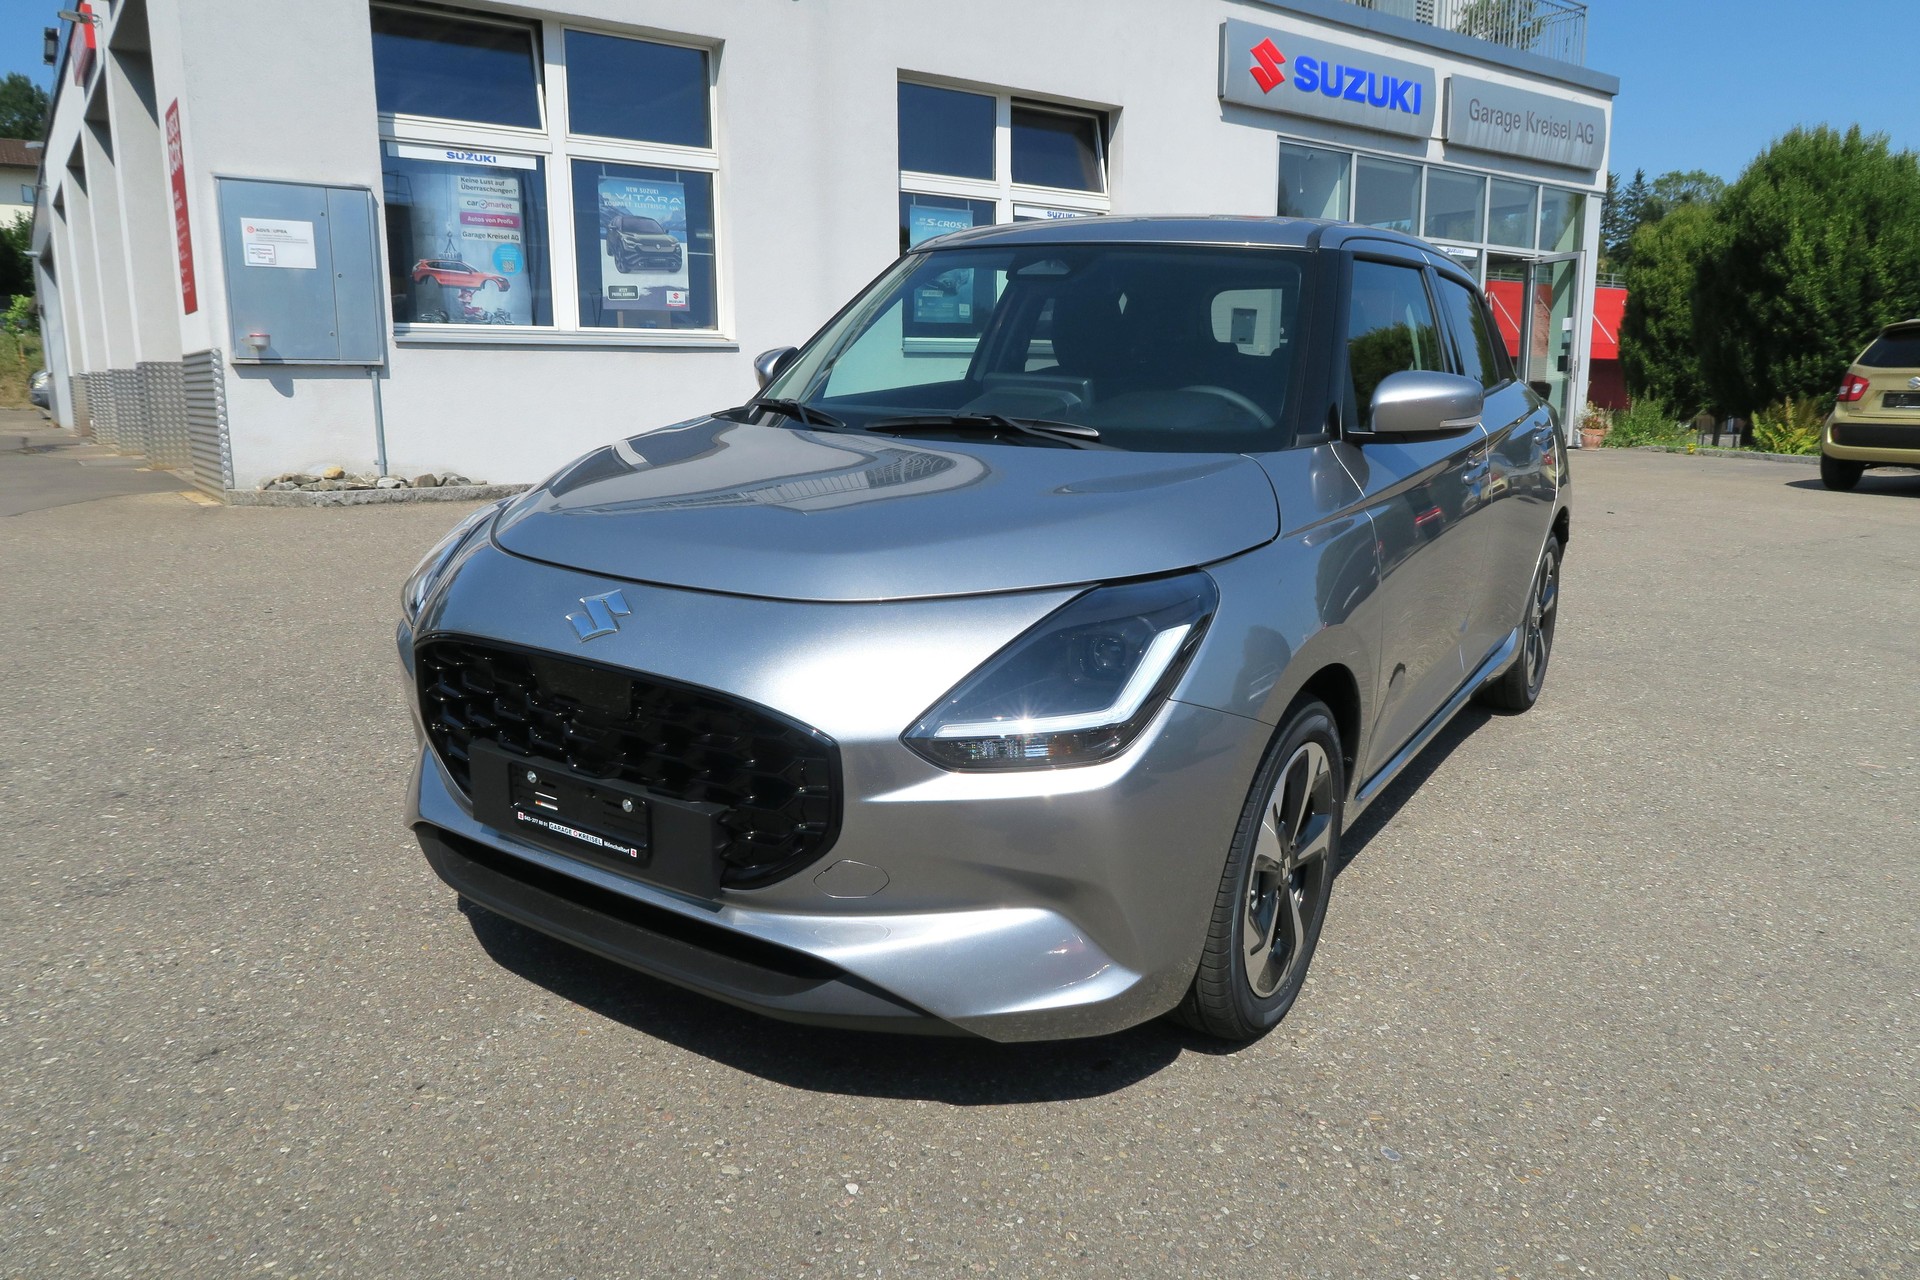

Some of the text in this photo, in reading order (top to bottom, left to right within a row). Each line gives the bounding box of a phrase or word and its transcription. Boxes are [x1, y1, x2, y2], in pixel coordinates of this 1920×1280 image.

[1293, 55, 1421, 115] SUZUKI
[1469, 98, 1595, 144] Garage Kreisel AG
[446, 151, 497, 163] SUZUKI
[461, 183, 516, 194] Überraschungen?
[615, 193, 681, 204] VITARA
[462, 231, 486, 239] Garage
[549, 822, 573, 836] GARAGE
[578, 831, 602, 845] KREISEL
